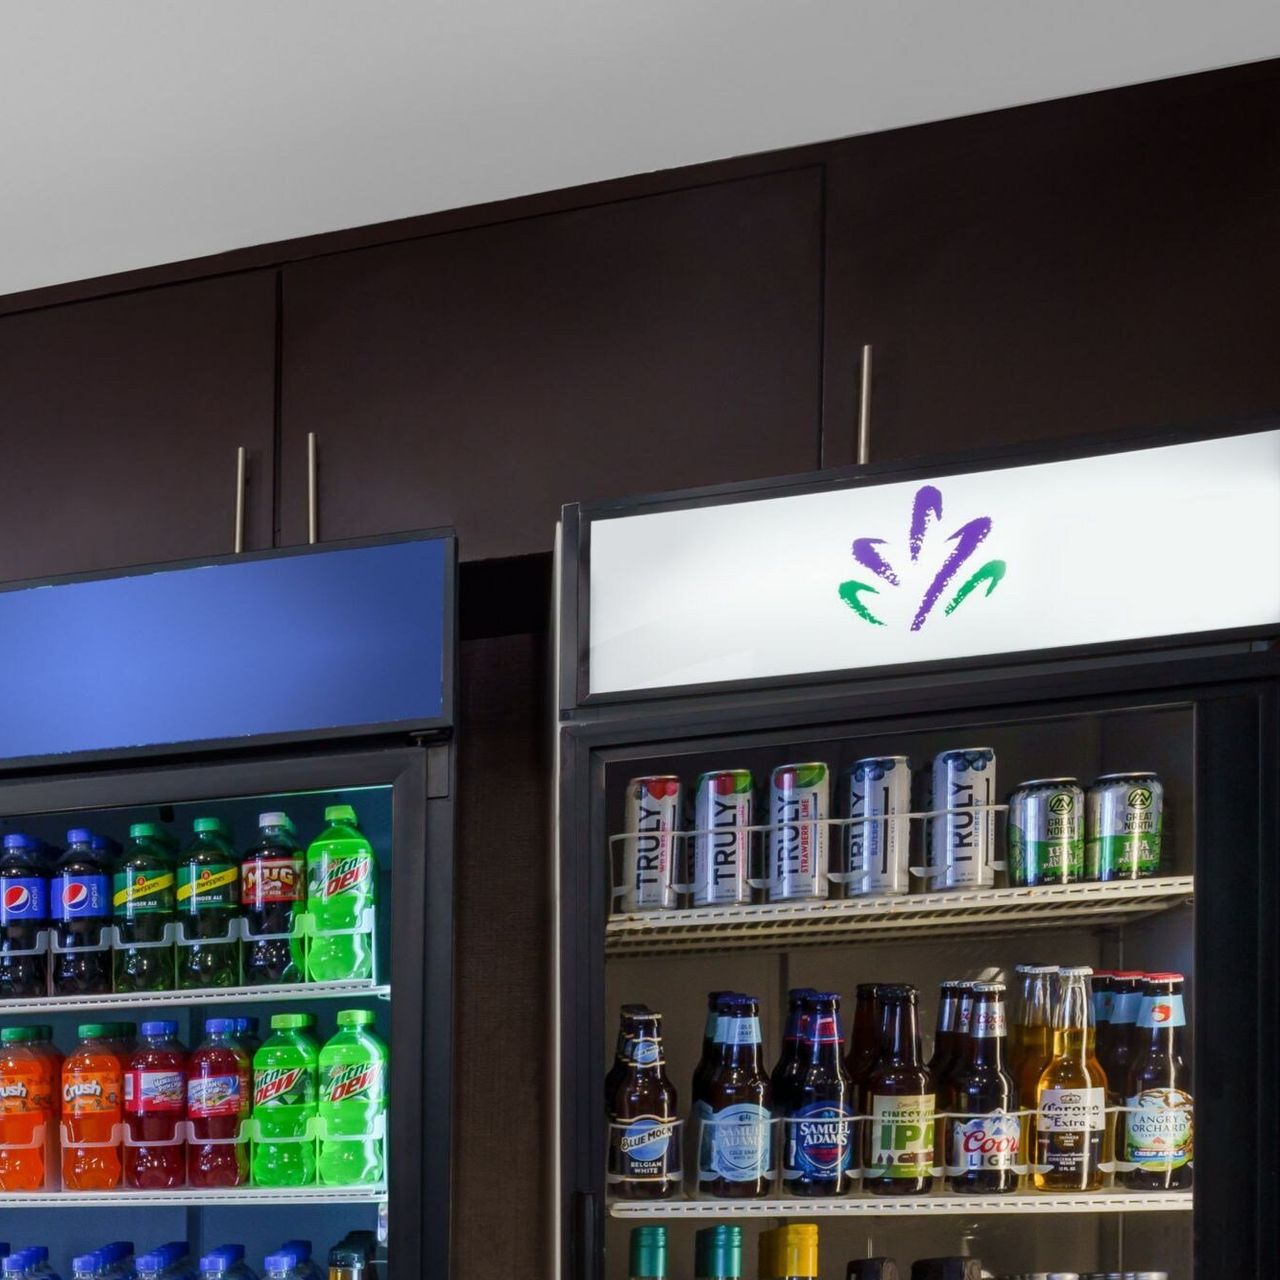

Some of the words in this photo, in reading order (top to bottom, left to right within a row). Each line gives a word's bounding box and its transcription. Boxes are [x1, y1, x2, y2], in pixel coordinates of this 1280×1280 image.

[801, 799, 809, 819] LIME
[636, 804, 661, 890] TRULY
[713, 800, 737, 886] TRULY
[776, 796, 800, 880] TRULY
[801, 823, 809, 873] STRAWBERR
[248, 868, 294, 887] MUG
[63, 1081, 102, 1101] Crush
[800, 1121, 851, 1135] SAMUEL
[1054, 1117, 1085, 1128] Extra
[1132, 1123, 1186, 1132] ORCHARD
[1140, 1114, 1178, 1124] ANGRY
[620, 1132, 647, 1152] BLUE
[647, 1126, 673, 1144] MOON
[804, 1133, 848, 1146] ADAMS
[630, 1161, 662, 1169] BELGIAN
[968, 1154, 1013, 1167] LIGH
